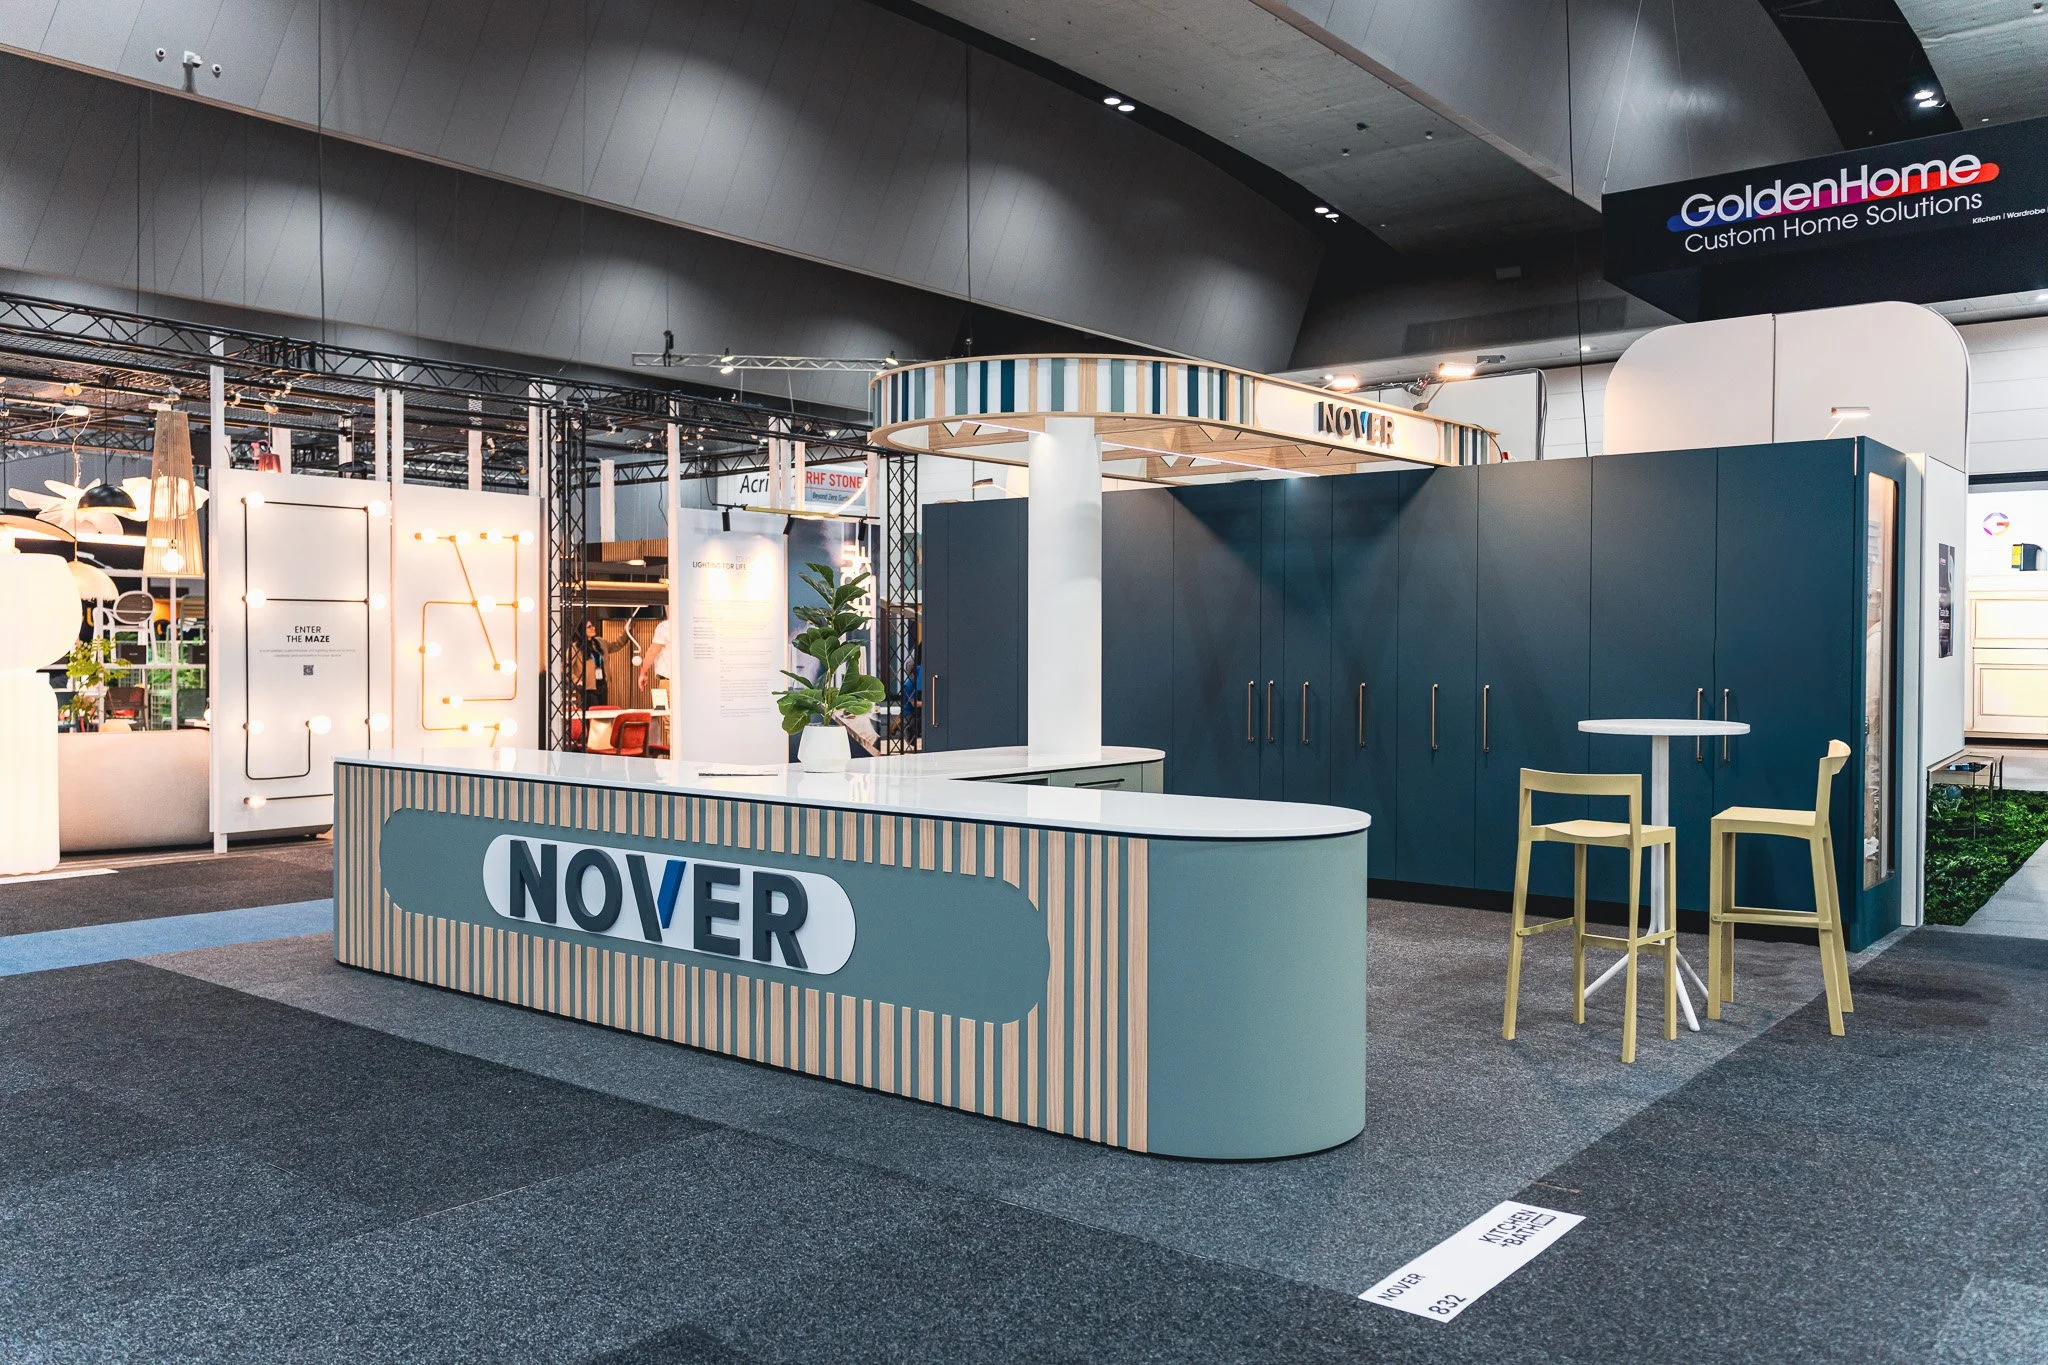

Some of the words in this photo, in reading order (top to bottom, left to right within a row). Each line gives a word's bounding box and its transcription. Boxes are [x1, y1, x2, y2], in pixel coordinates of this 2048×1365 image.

[1681, 154, 1981, 226] GoldenHome
[1685, 226, 1775, 252] Custom
[1784, 213, 1858, 238] Home
[1866, 193, 1982, 225] Solutions
[1972, 214, 2001, 224] Kitchen
[2006, 208, 2046, 219] Wardrobe
[1317, 401, 1395, 446] NOVER
[806, 471, 827, 485] RHF
[829, 473, 863, 489] STONE
[286, 635, 303, 643] THE
[304, 635, 331, 643] MAZE
[294, 625, 322, 634] ENTER
[509, 839, 809, 970] NOVER
[1478, 1208, 1538, 1244] KITCHEN
[1499, 1222, 1545, 1248] +BATH
[1377, 1273, 1426, 1301] NOVER
[1428, 1294, 1468, 1315] 832
